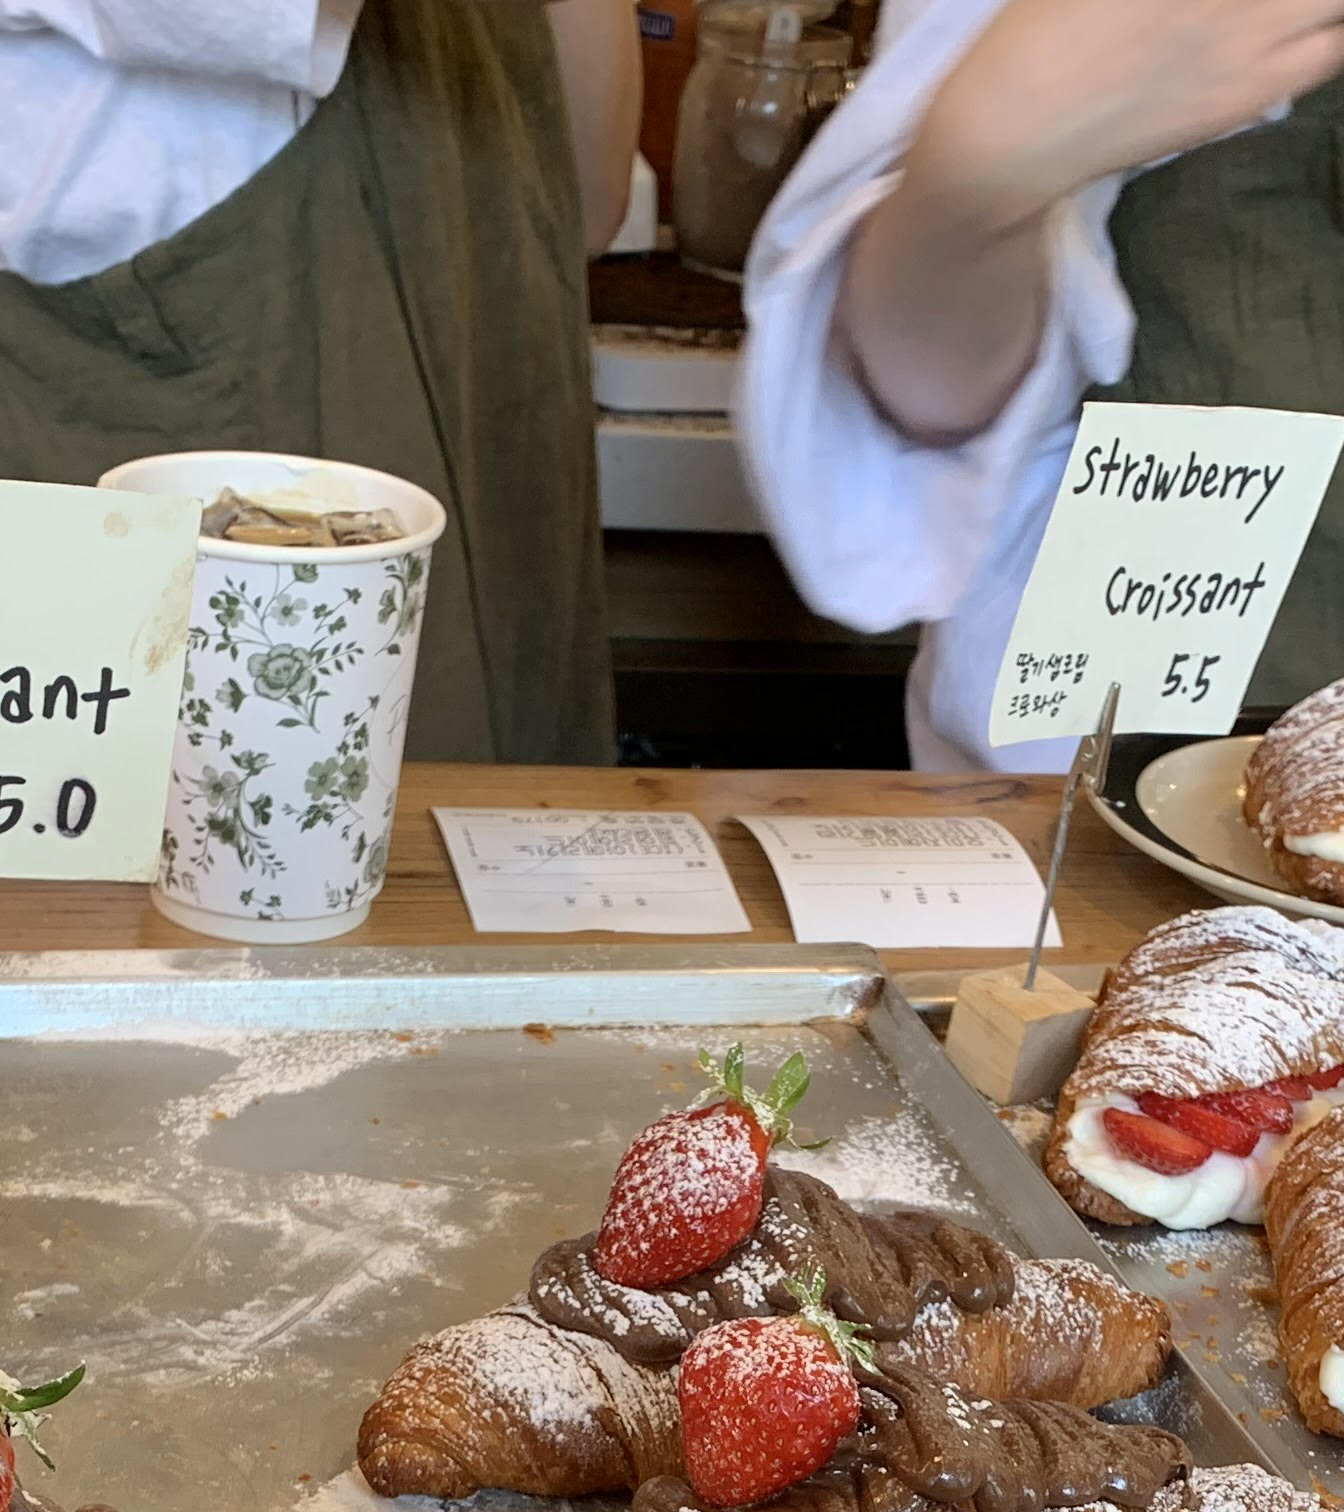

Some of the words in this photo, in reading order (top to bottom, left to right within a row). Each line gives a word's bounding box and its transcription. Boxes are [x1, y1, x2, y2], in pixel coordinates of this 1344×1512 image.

[1072, 437, 1285, 524] Strawberry
[1105, 561, 1266, 621] Croissant
[1008, 690, 1068, 718] 크로와상
[1161, 653, 1221, 703] 5.5
